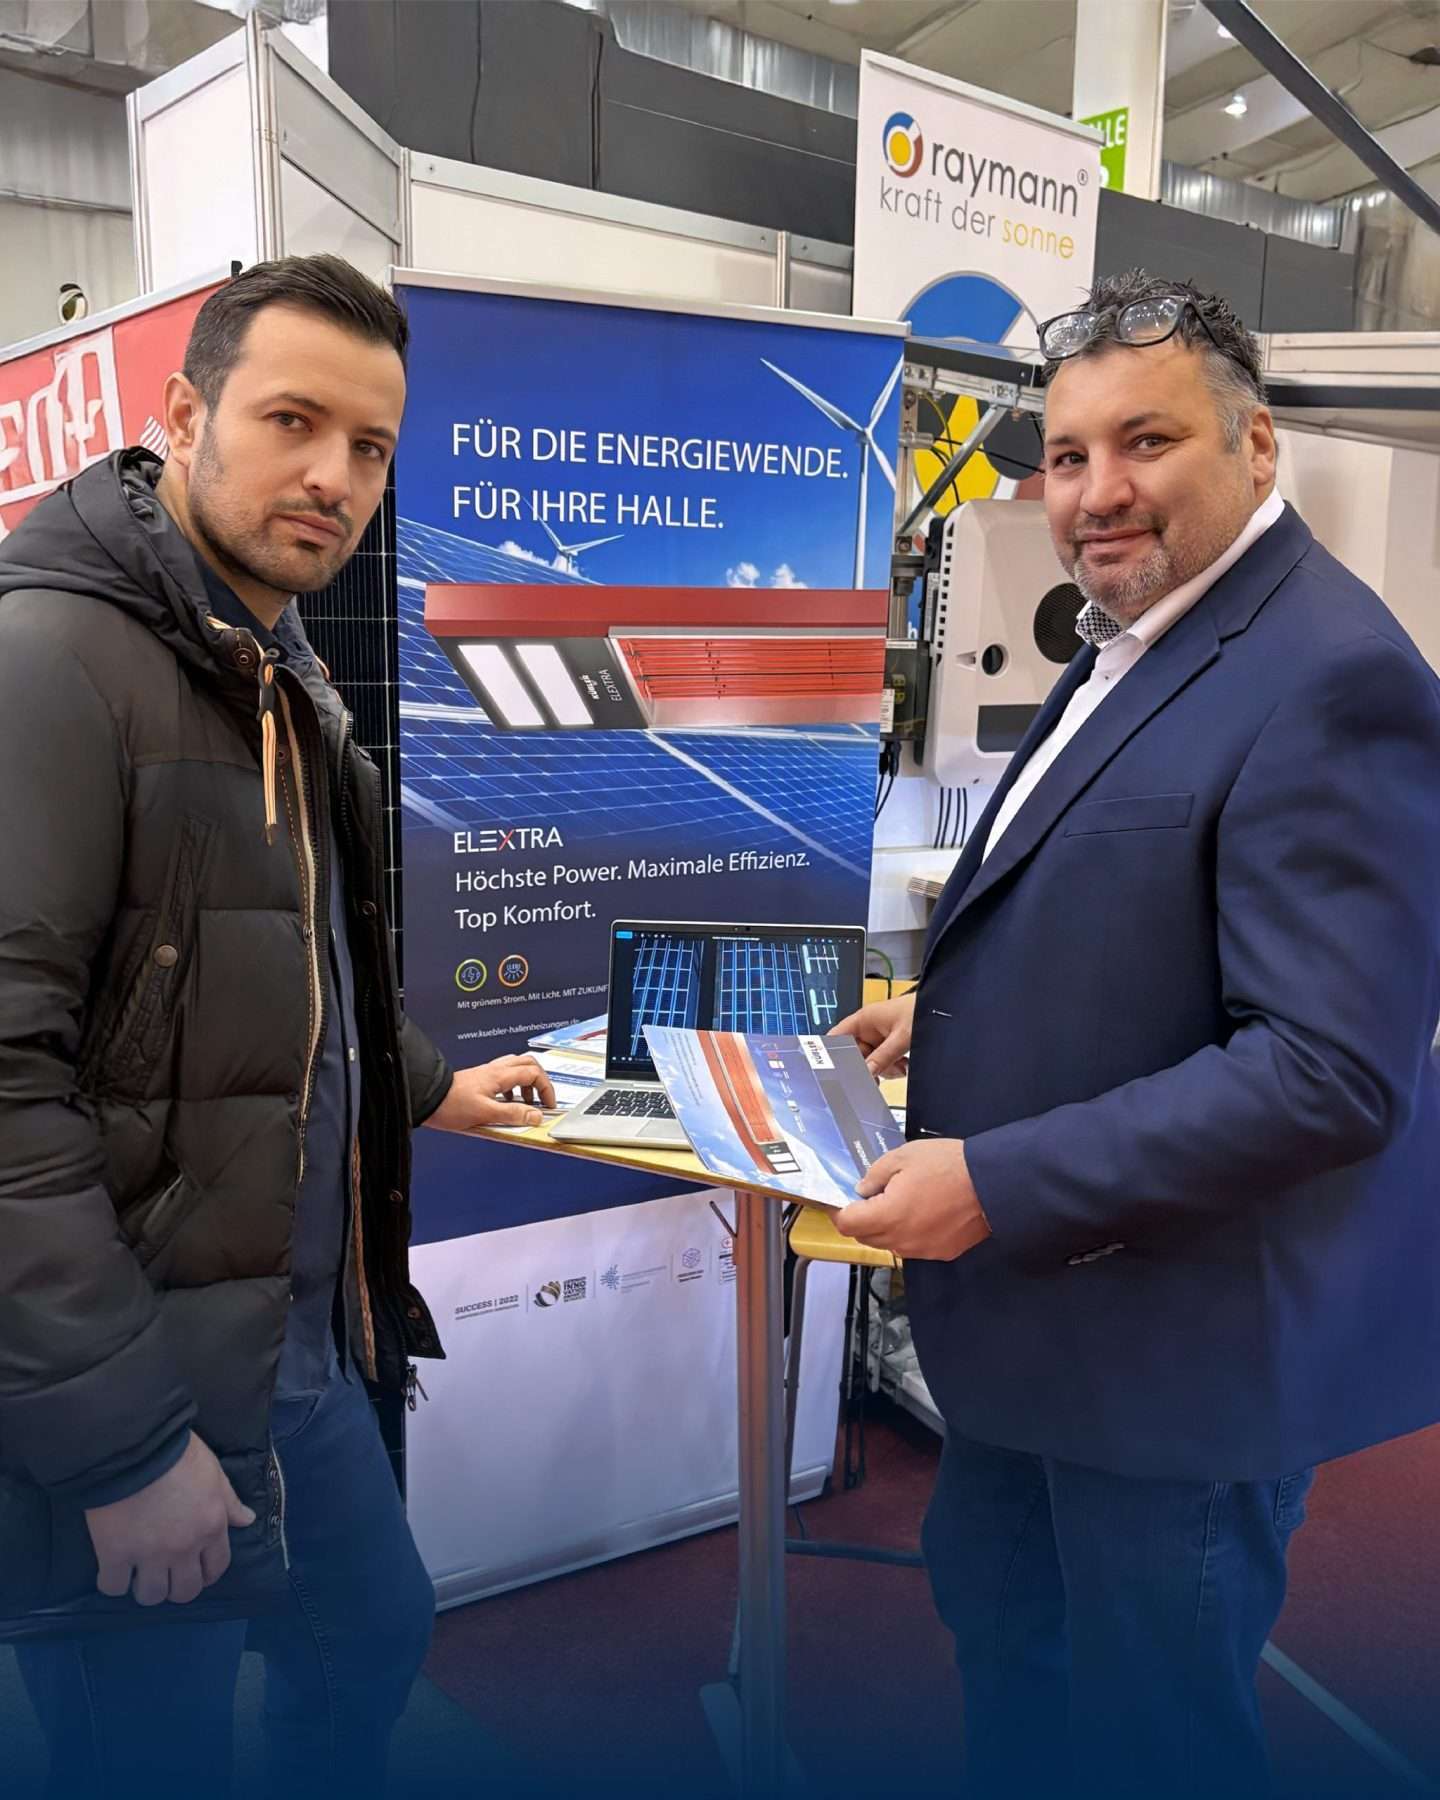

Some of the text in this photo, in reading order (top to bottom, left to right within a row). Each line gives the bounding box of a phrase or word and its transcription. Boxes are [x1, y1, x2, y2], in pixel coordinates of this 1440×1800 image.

[879, 176, 1075, 260] kraft der sonne
[452, 417, 849, 480] FÜR DIE ENERGIEWENDE.
[453, 480, 725, 530] FÜR IHRE HALLE.
[454, 826, 564, 854] ELEXTRA
[455, 850, 811, 893] Höchste Power. Maximale Effizienz.
[454, 900, 597, 932] Top Komfort.
[457, 984, 609, 1010] Mit grünem Strom. Mit Licht. MIT ZUKUNF
